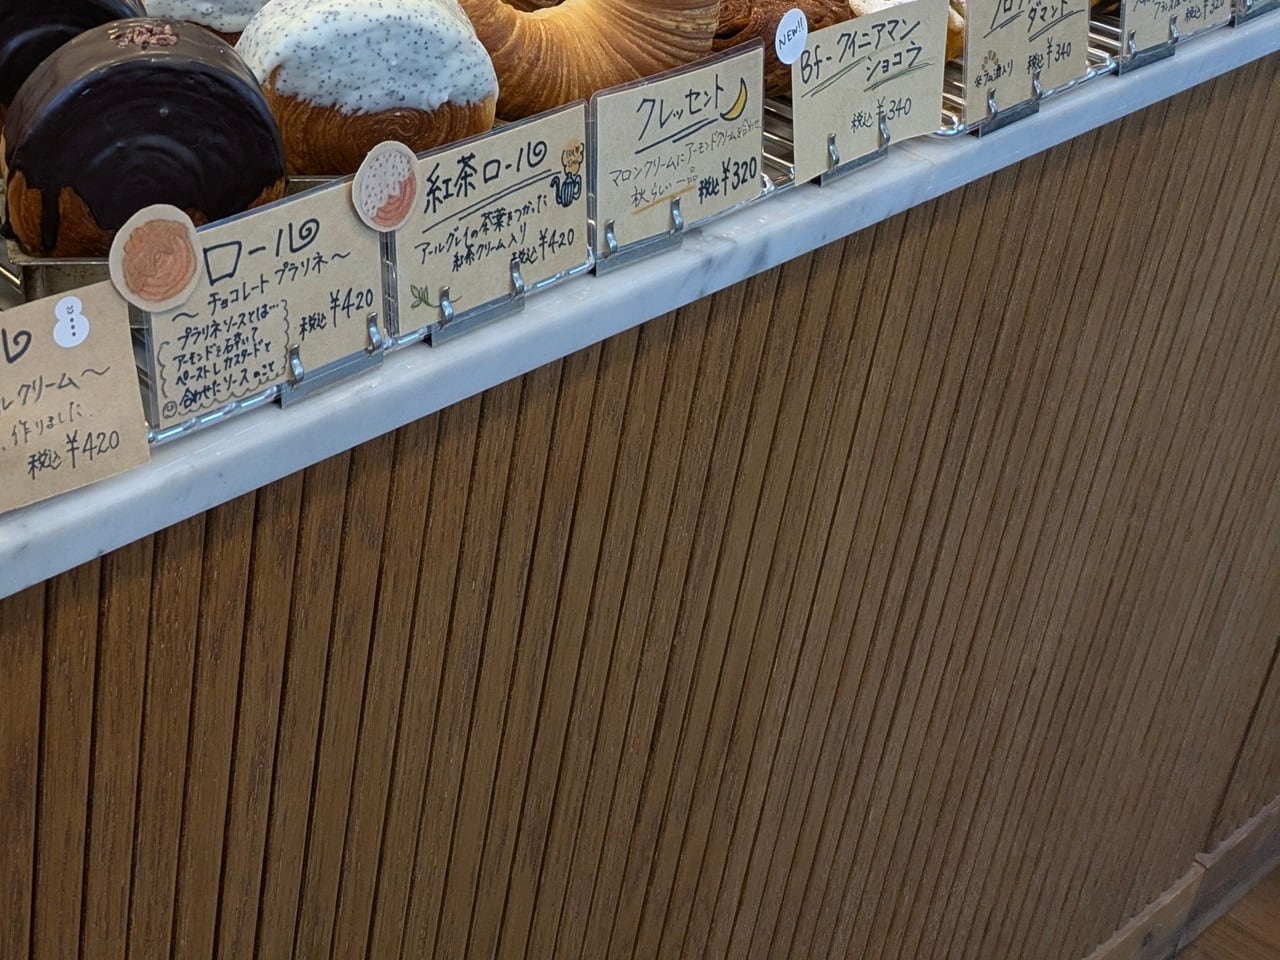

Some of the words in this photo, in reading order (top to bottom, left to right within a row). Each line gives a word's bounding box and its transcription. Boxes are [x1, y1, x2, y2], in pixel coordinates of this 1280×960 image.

[778, 16, 805, 51] NEW!!
[1184, 5, 1202, 23] 税込
[865, 40, 923, 82] ショコラ
[1026, 51, 1045, 75] 税込
[1045, 37, 1072, 69] ¥340
[636, 73, 725, 142] クレッセント
[850, 110, 874, 134] 税込
[876, 96, 912, 121] ¥340
[424, 140, 548, 214] 紅茶ロール
[698, 176, 720, 204] 税込
[721, 156, 758, 198] ¥320
[203, 218, 320, 286] ロール
[452, 222, 527, 273] 紅茶クリーム入り
[538, 227, 575, 262] ¥420
[299, 312, 327, 341] 税込
[329, 287, 374, 328] ¥420
[179, 360, 275, 409] 合わせたソースのこと
[27, 449, 63, 480] 税込
[66, 429, 121, 469] ¥420
